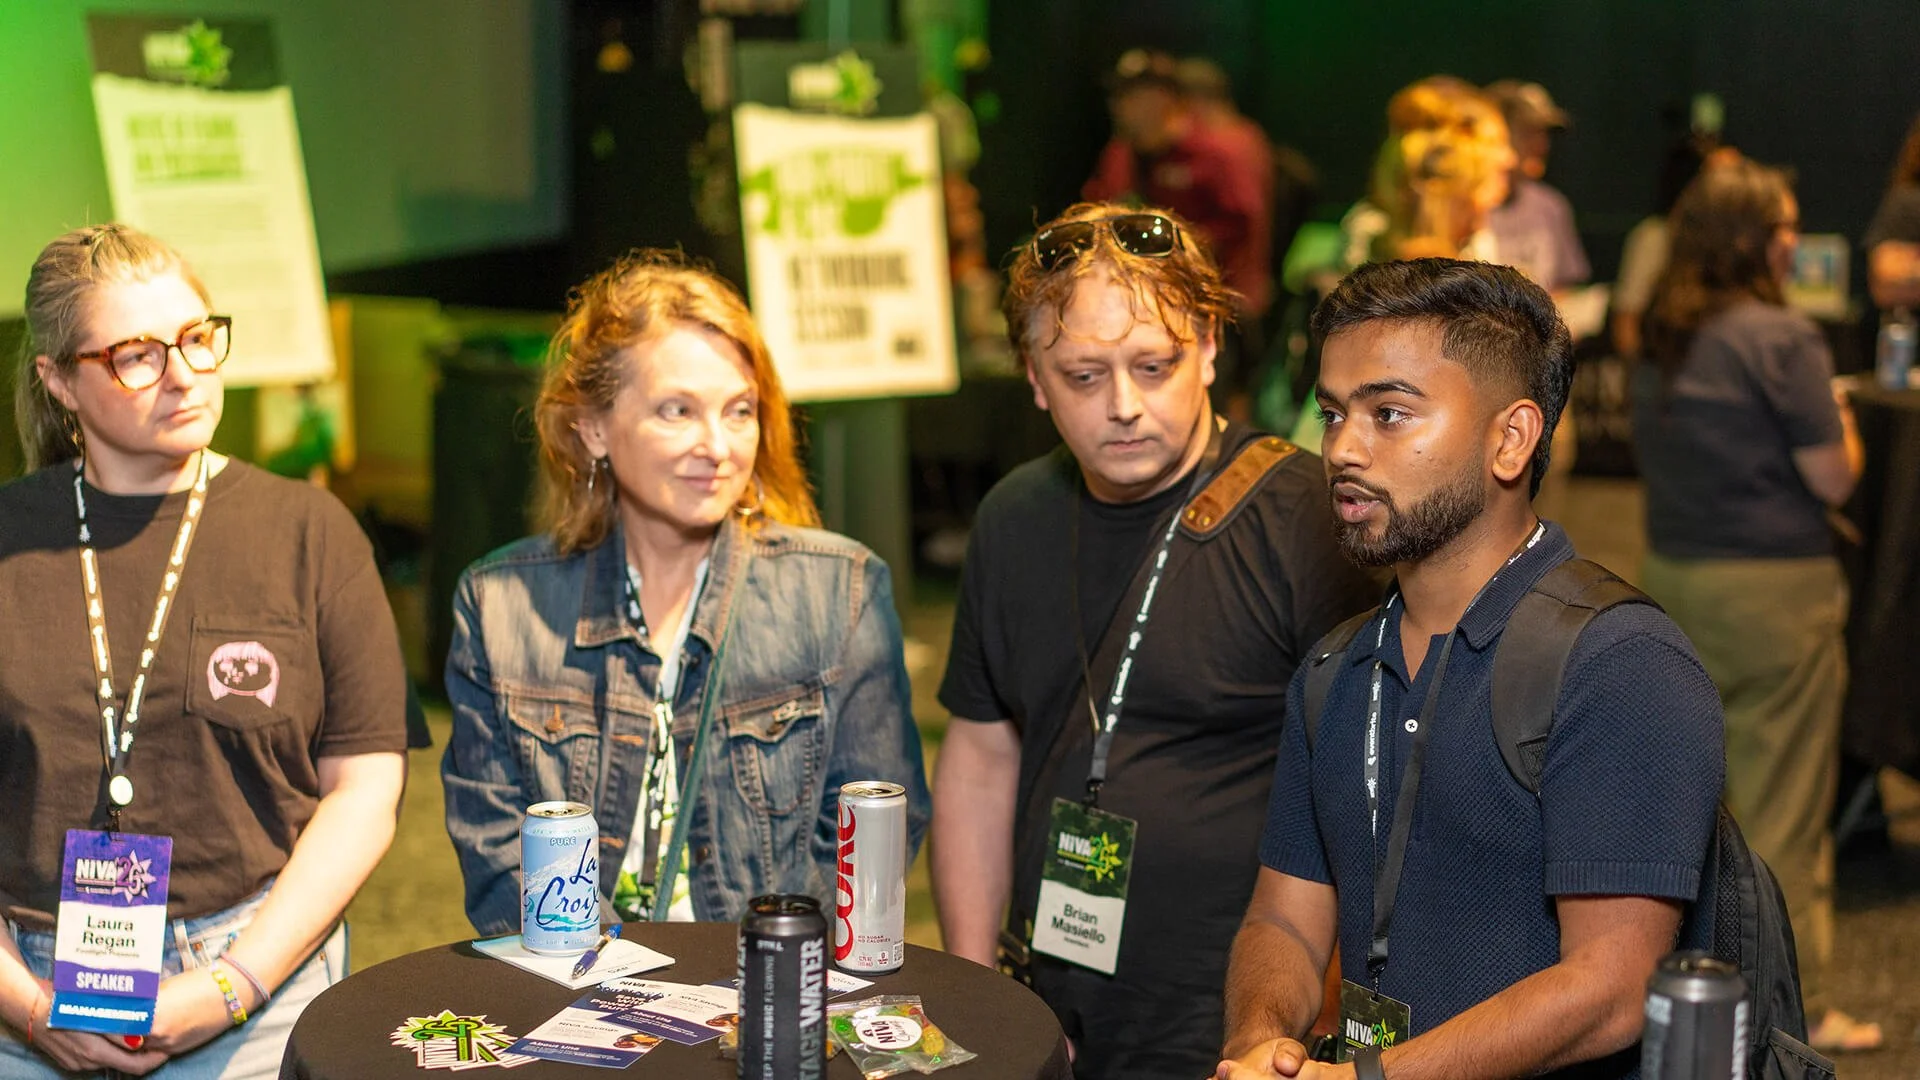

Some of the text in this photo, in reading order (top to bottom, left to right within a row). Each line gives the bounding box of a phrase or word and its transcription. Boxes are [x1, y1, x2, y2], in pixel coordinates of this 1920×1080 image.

[1369, 711, 1377, 756] eventbrite
[549, 836, 577, 847] PURE
[1058, 832, 1092, 857] NIVA
[75, 858, 117, 880] NIVA
[569, 838, 597, 885] La
[536, 876, 599, 926] Croix
[86, 915, 134, 931] Laura
[1063, 903, 1098, 925] Brian
[82, 931, 135, 948] Regan
[1051, 915, 1106, 944] Masiello
[76, 971, 134, 992] SPEAKER
[58, 1003, 149, 1022] MANAGEMENT
[870, 1020, 897, 1044] NIVA
[1346, 1018, 1373, 1046] NIVA
